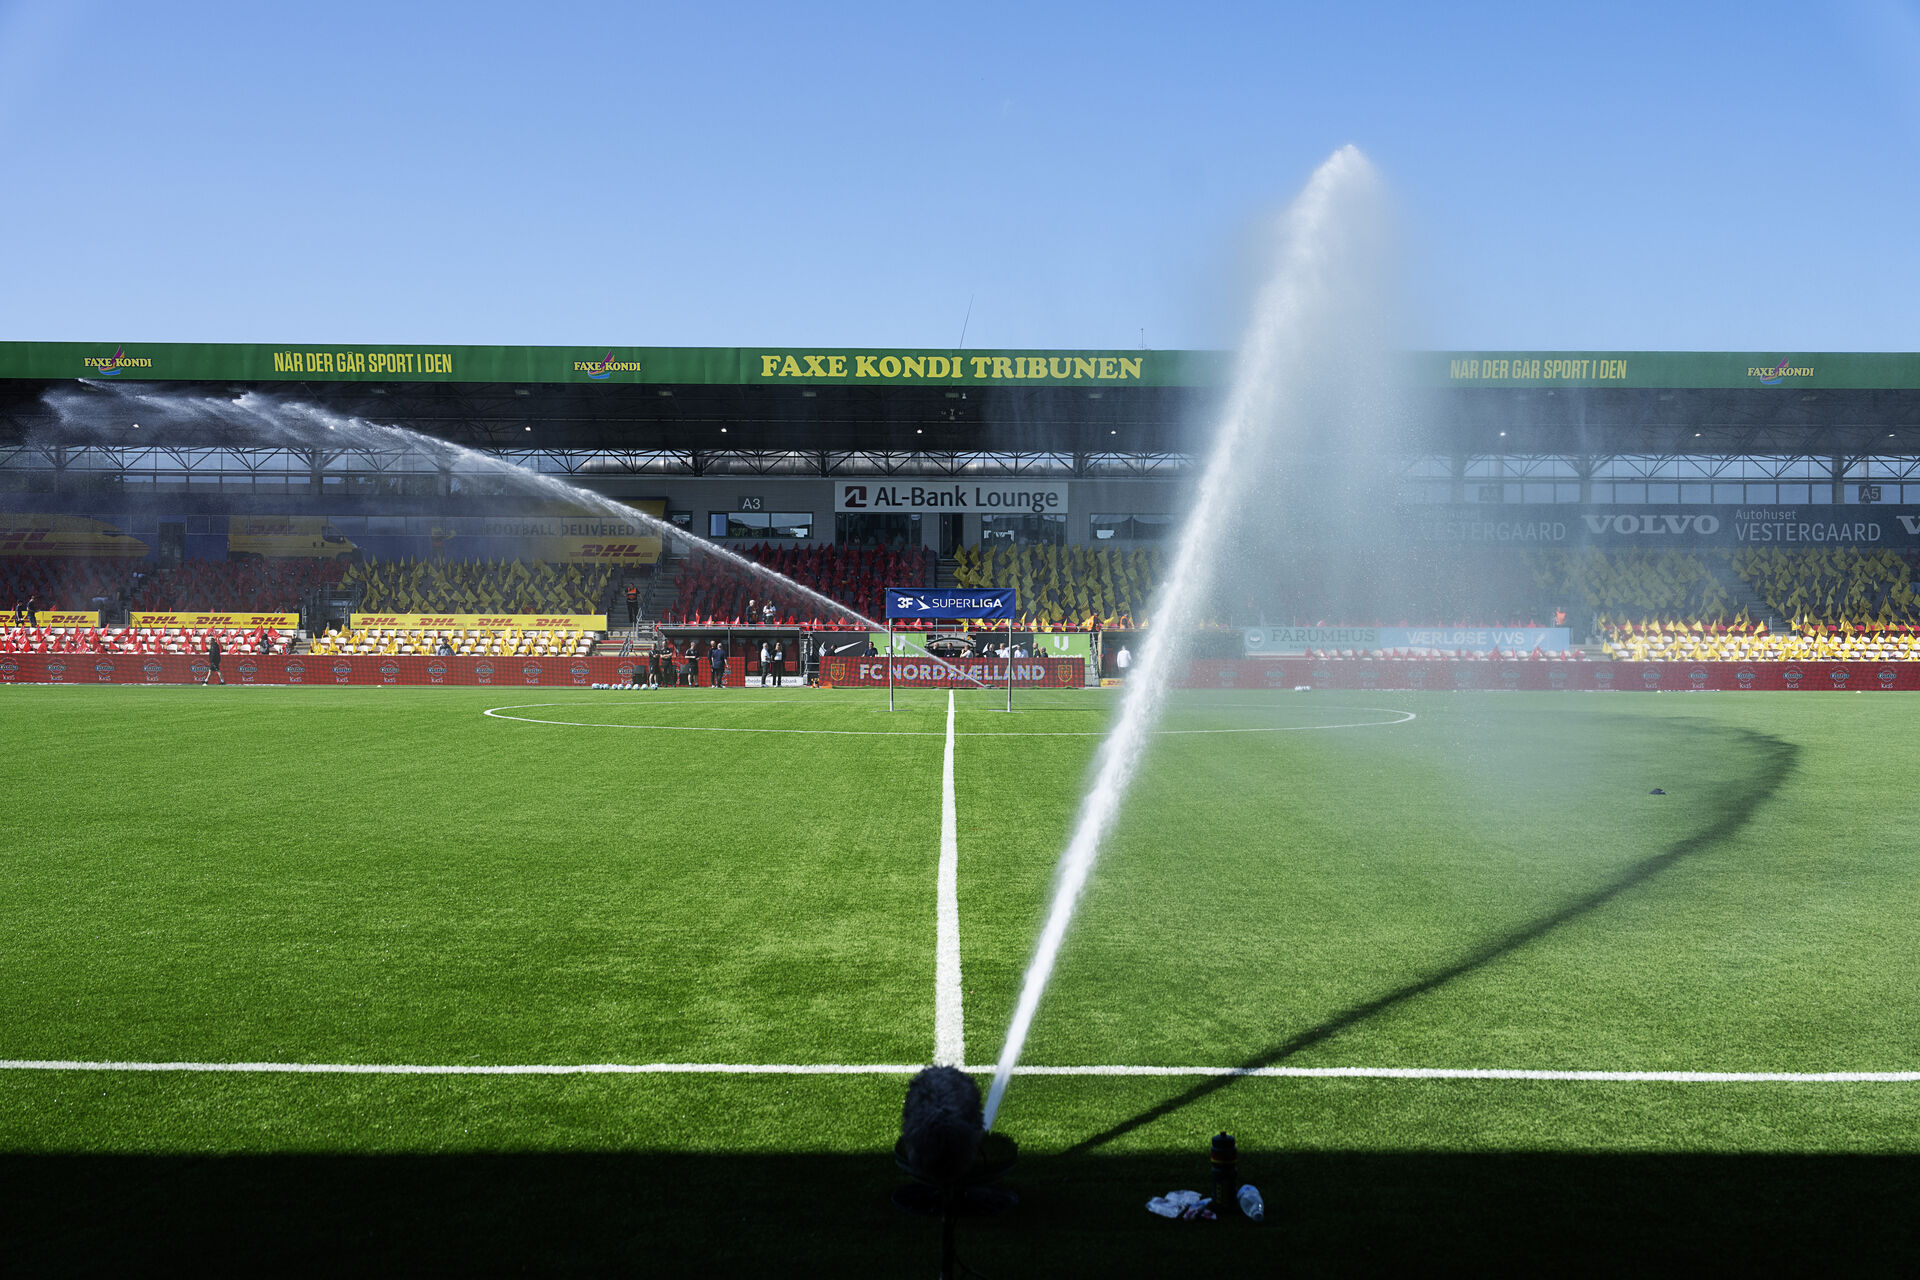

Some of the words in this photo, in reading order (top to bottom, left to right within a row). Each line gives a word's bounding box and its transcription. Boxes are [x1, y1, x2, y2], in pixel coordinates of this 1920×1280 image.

[84, 357, 113, 367] FAXE
[115, 358, 153, 368] KONDI
[274, 350, 304, 372] NÅR
[306, 352, 334, 373] DER
[337, 351, 366, 373] GÅR
[368, 353, 414, 374] SPORT
[417, 353, 422, 374] I
[425, 353, 453, 374] DEN
[573, 361, 602, 371] FAXE
[604, 362, 642, 371] KONDI
[761, 355, 848, 378] FAXE
[855, 355, 964, 379] KONDI
[970, 357, 1144, 380] TRIBUNEN
[1482, 360, 1509, 379] DER
[1543, 360, 1590, 379] SPORT
[1600, 360, 1627, 379] DEN
[1747, 367, 1776, 377] FAXE
[1777, 368, 1815, 377] KONDI
[874, 485, 968, 508] AL-Bank
[975, 487, 1059, 513] Lounge
[1861, 487, 1880, 500] A5
[742, 498, 762, 510] A3
[1735, 508, 1797, 521] Autohuset
[561, 524, 636, 536] DELIVERED
[1581, 514, 1721, 534] VOLVO
[1735, 522, 1882, 542] VESTERGAARD
[580, 544, 641, 558] DHL
[897, 597, 914, 609] 3F
[932, 597, 1003, 609] SUPERLIGA
[51, 615, 89, 624] DHL
[141, 616, 180, 625] DHL
[196, 616, 234, 625] DHL
[250, 616, 288, 625] DHL
[360, 617, 400, 626] DHL
[419, 617, 457, 626] DHL
[477, 618, 516, 627] DHL
[535, 618, 574, 627] DHL
[1271, 629, 1376, 642] FARUMHUS
[1406, 631, 1487, 646] VÆRLØSE
[1492, 631, 1525, 646] VVS
[859, 663, 883, 681] FC
[889, 664, 1046, 681] NORDSJÆLLAND
